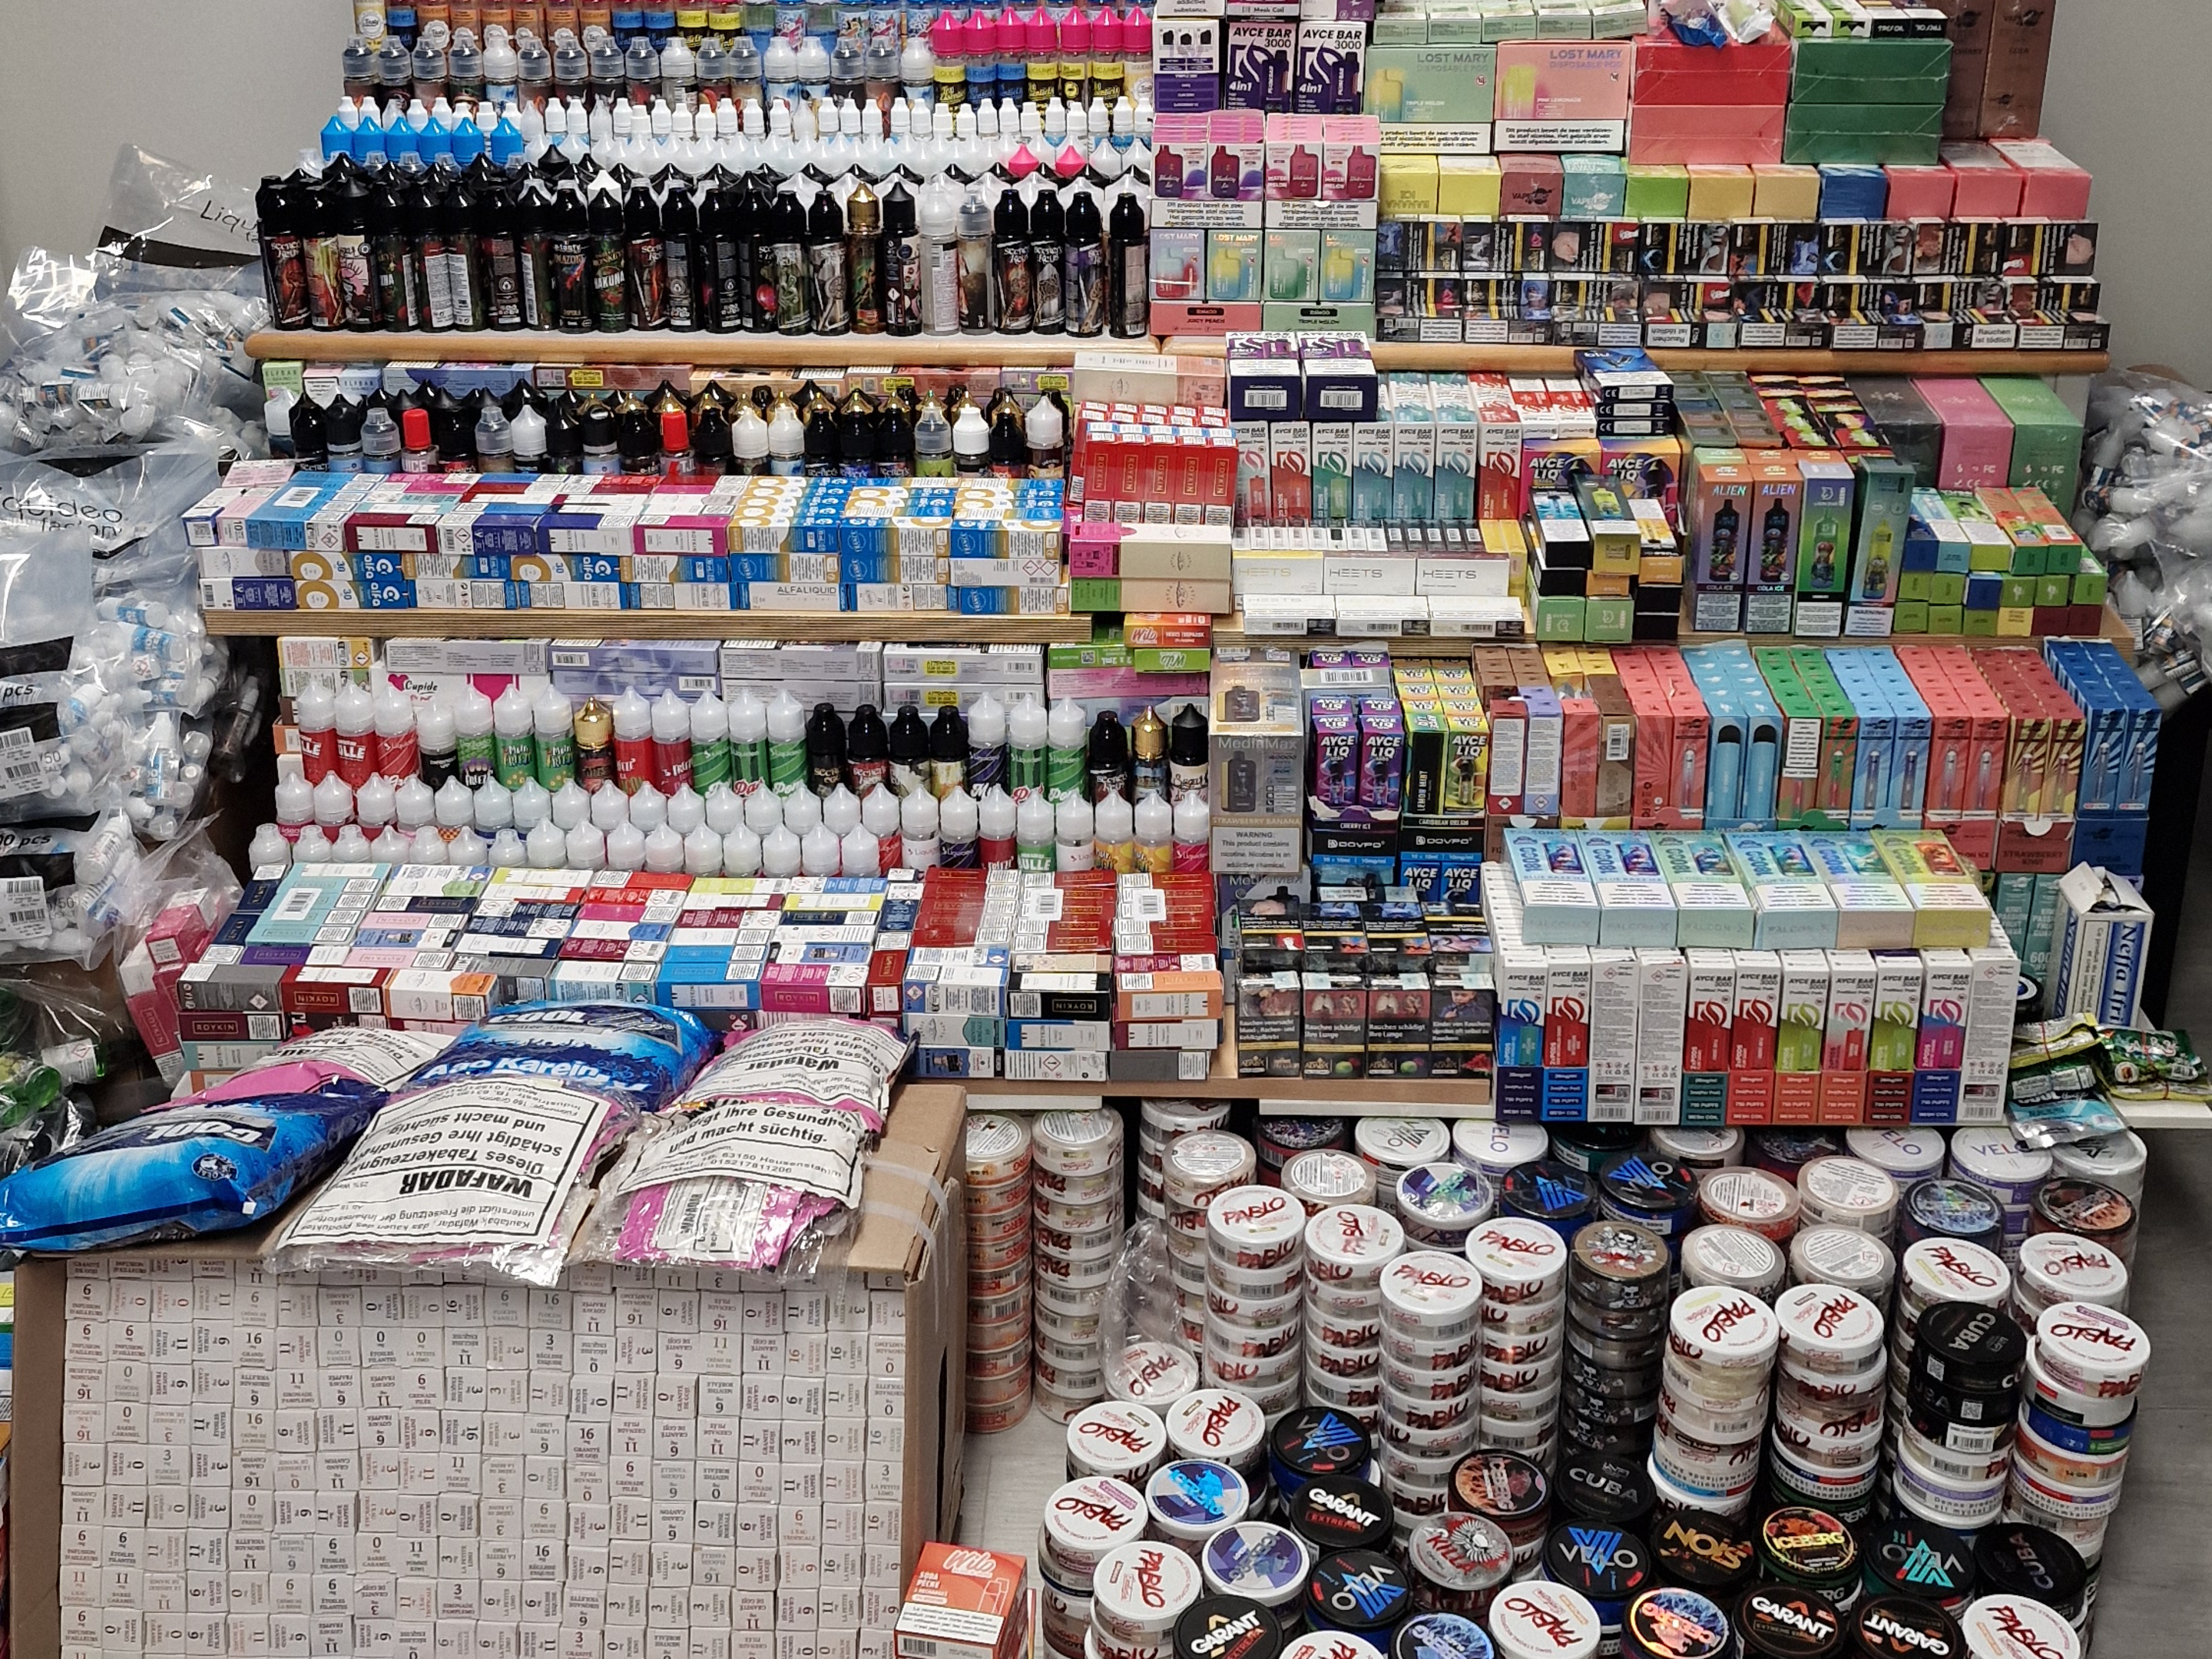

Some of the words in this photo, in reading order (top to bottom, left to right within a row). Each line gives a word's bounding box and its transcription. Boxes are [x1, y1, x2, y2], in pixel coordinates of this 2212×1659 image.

[1233, 28, 1263, 38] AYCE
[1267, 28, 1292, 38] BAR
[1303, 29, 1334, 39] AYCE
[1336, 30, 1363, 40] BAR
[1264, 39, 1292, 48] 3000
[1334, 40, 1362, 50] 3000
[1417, 53, 1451, 63] LOST
[1453, 53, 1488, 63] MARY
[1550, 49, 1584, 60] LOST
[1587, 49, 1623, 60] MARY
[1299, 84, 1323, 93] 4in1
[200, 200, 257, 233] Liqu
[1236, 233, 1259, 242] MARY
[1979, 327, 2012, 336] Rauchen
[1987, 335, 2012, 344] tödlich
[1528, 458, 1565, 469] AYCE
[1607, 458, 1644, 469] AYCE
[1096, 455, 1108, 490] ROYKIN
[1125, 456, 1136, 492] ROYKIN
[1156, 457, 1166, 493] ROYKIN
[1186, 459, 1197, 494] ROYKIN
[1534, 469, 1560, 481] LIQ
[1712, 485, 1747, 496] ALIEN
[1762, 485, 1796, 495] ALIEN
[2, 495, 123, 524] quideo
[1330, 568, 1382, 578] HEETS
[1423, 570, 1477, 579] HEETS
[777, 586, 837, 595] ALFALIQUID
[405, 680, 438, 692] Cupide
[1320, 736, 1356, 747] AYCE
[1366, 736, 1402, 747] AYCE
[1452, 735, 1487, 746] AYCE
[1326, 747, 1350, 758] LIQ
[1371, 747, 1396, 759] LIQ
[1456, 746, 1482, 758] LIQ
[1236, 831, 1276, 839] WARNING:
[1237, 840, 1262, 849] product
[1339, 839, 1382, 849] DOVPO
[1404, 867, 1438, 879] AYCE
[1444, 867, 1479, 879] AYCE
[1408, 879, 1432, 890] LIQ
[1448, 879, 1474, 890] LIQ
[2112, 925, 2137, 982] Neffa
[1055, 1002, 1094, 1012] ROYKIN
[2109, 990, 2128, 1025] Ifri
[197, 1022, 235, 1032] ROYKIN
[495, 1057, 602, 1080] Karein
[453, 1112, 510, 1126] macht
[726, 1107, 757, 1120] Ihre
[512, 1119, 546, 1133] und
[449, 1129, 483, 1143] Ihre
[700, 1121, 755, 1141] macht
[759, 1123, 828, 1144] süchtig.
[486, 1132, 563, 1157] schädigt
[352, 1148, 478, 1174] Tabakerzeugni
[485, 1151, 545, 1175] Dieses
[399, 1169, 533, 1199] WAFADAR
[461, 1206, 476, 1214] die
[1222, 1197, 1286, 1227] PABLO
[1479, 1229, 1555, 1257] PABLO
[1929, 1245, 1998, 1288] PABLO
[1392, 1264, 1471, 1289] PABLO
[1701, 1296, 1757, 1342] PABLO
[1813, 1295, 1859, 1339] PABLO
[246, 1332, 262, 1344] 16
[376, 1331, 385, 1343] 0
[417, 1332, 426, 1343] 0
[1949, 1313, 1997, 1352] CUBA
[2051, 1323, 2137, 1353] PABLO
[830, 1346, 842, 1360] 16
[1202, 1396, 1242, 1447] PABLO
[1078, 1422, 1153, 1454] PABLO
[756, 1466, 763, 1478] 0
[882, 1465, 890, 1476] 3
[1569, 1467, 1640, 1504] CUBA
[1308, 1487, 1381, 1527] GARANT
[1055, 1496, 1134, 1532] PABLO
[1774, 1532, 1846, 1549] ICEBERG
[1140, 1548, 1165, 1608] PABLO
[1504, 1597, 1584, 1648] PABLO
[1751, 1597, 1834, 1638] GARANT
[1190, 1610, 1260, 1654] GARANT
[1866, 1613, 1951, 1656] GARANT
[1985, 1605, 2065, 1659] PABLO
